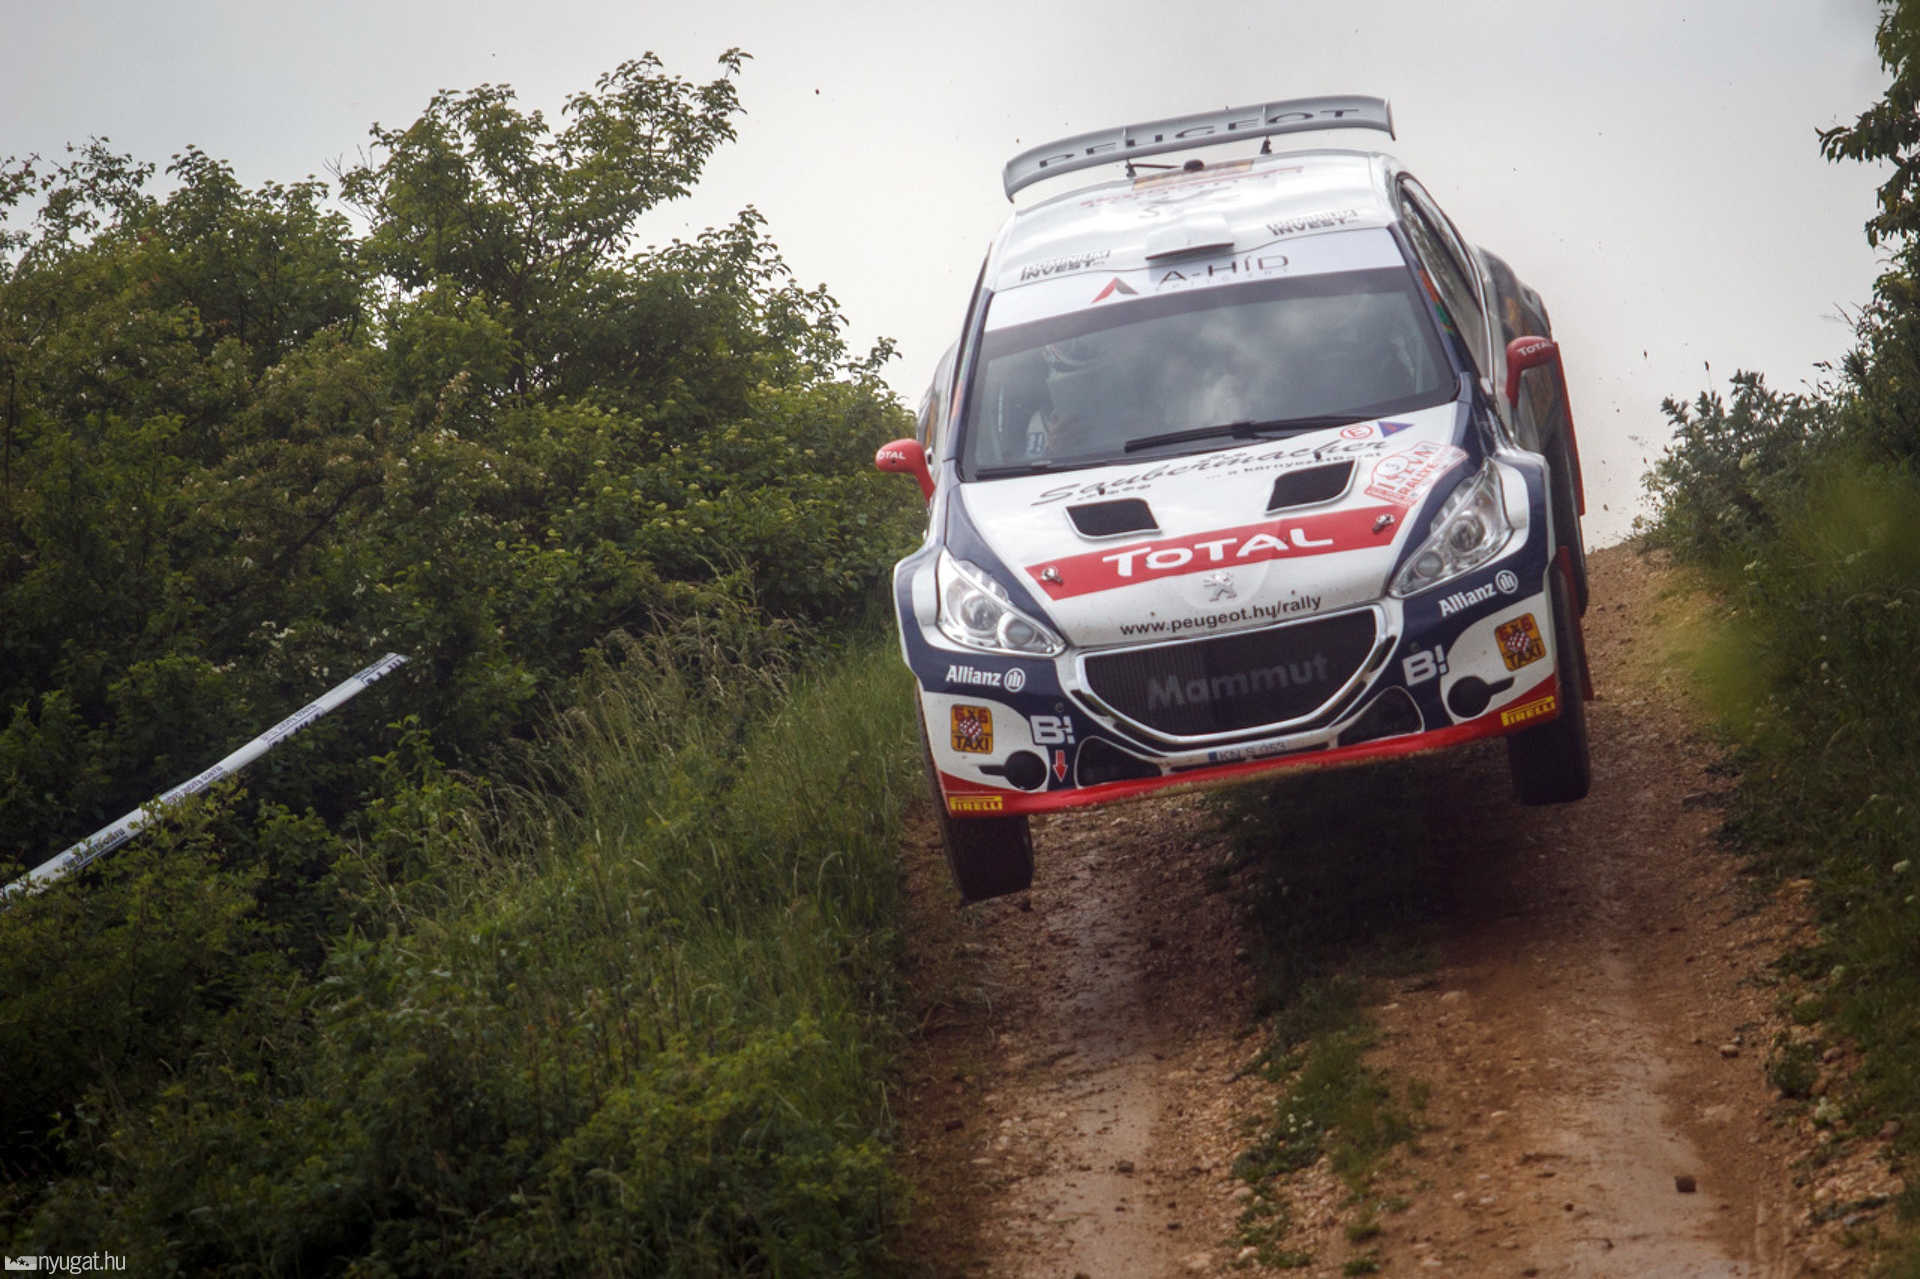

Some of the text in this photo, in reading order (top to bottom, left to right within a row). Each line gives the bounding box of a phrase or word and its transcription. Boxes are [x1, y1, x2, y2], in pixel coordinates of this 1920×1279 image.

[1101, 528, 1334, 578] TOTAL
[1120, 595, 1322, 636] www.peugeot.hu/rally
[1438, 583, 1497, 617] Allianz
[945, 665, 1002, 686] Allianz
[1147, 652, 1329, 707] Mammut
[1402, 644, 1449, 687] B!
[1501, 696, 1556, 727] PIRELLI
[955, 735, 989, 751] TAXI
[1030, 715, 1076, 744] B!
[950, 796, 1003, 811] PIRELLI
